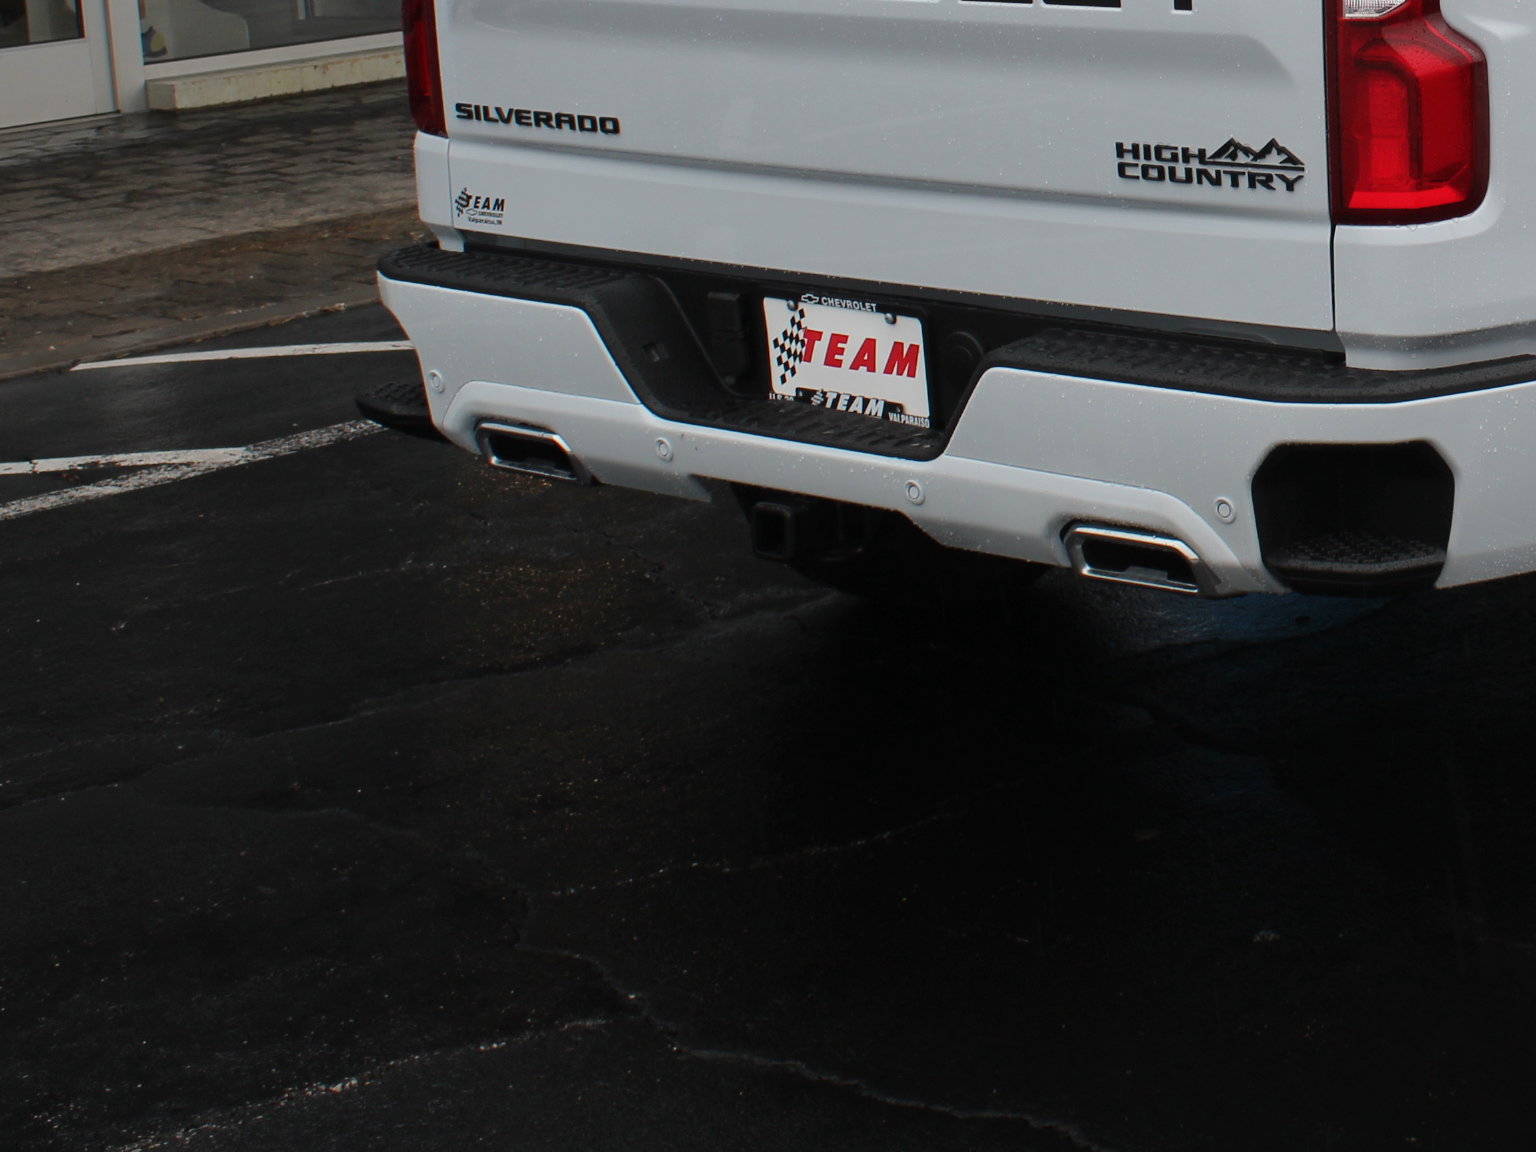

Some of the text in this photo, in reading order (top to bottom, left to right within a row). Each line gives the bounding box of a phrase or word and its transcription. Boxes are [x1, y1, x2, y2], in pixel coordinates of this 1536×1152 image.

[455, 102, 621, 135] SILVERADO
[1115, 141, 1207, 165] HIGH
[1117, 161, 1304, 192] COUNTRY
[465, 193, 505, 212] TEAM
[821, 297, 877, 313] CHEVROLET
[802, 328, 920, 379] TEAM
[825, 391, 886, 420] TEAM
[888, 411, 930, 429] VALPARAISO
